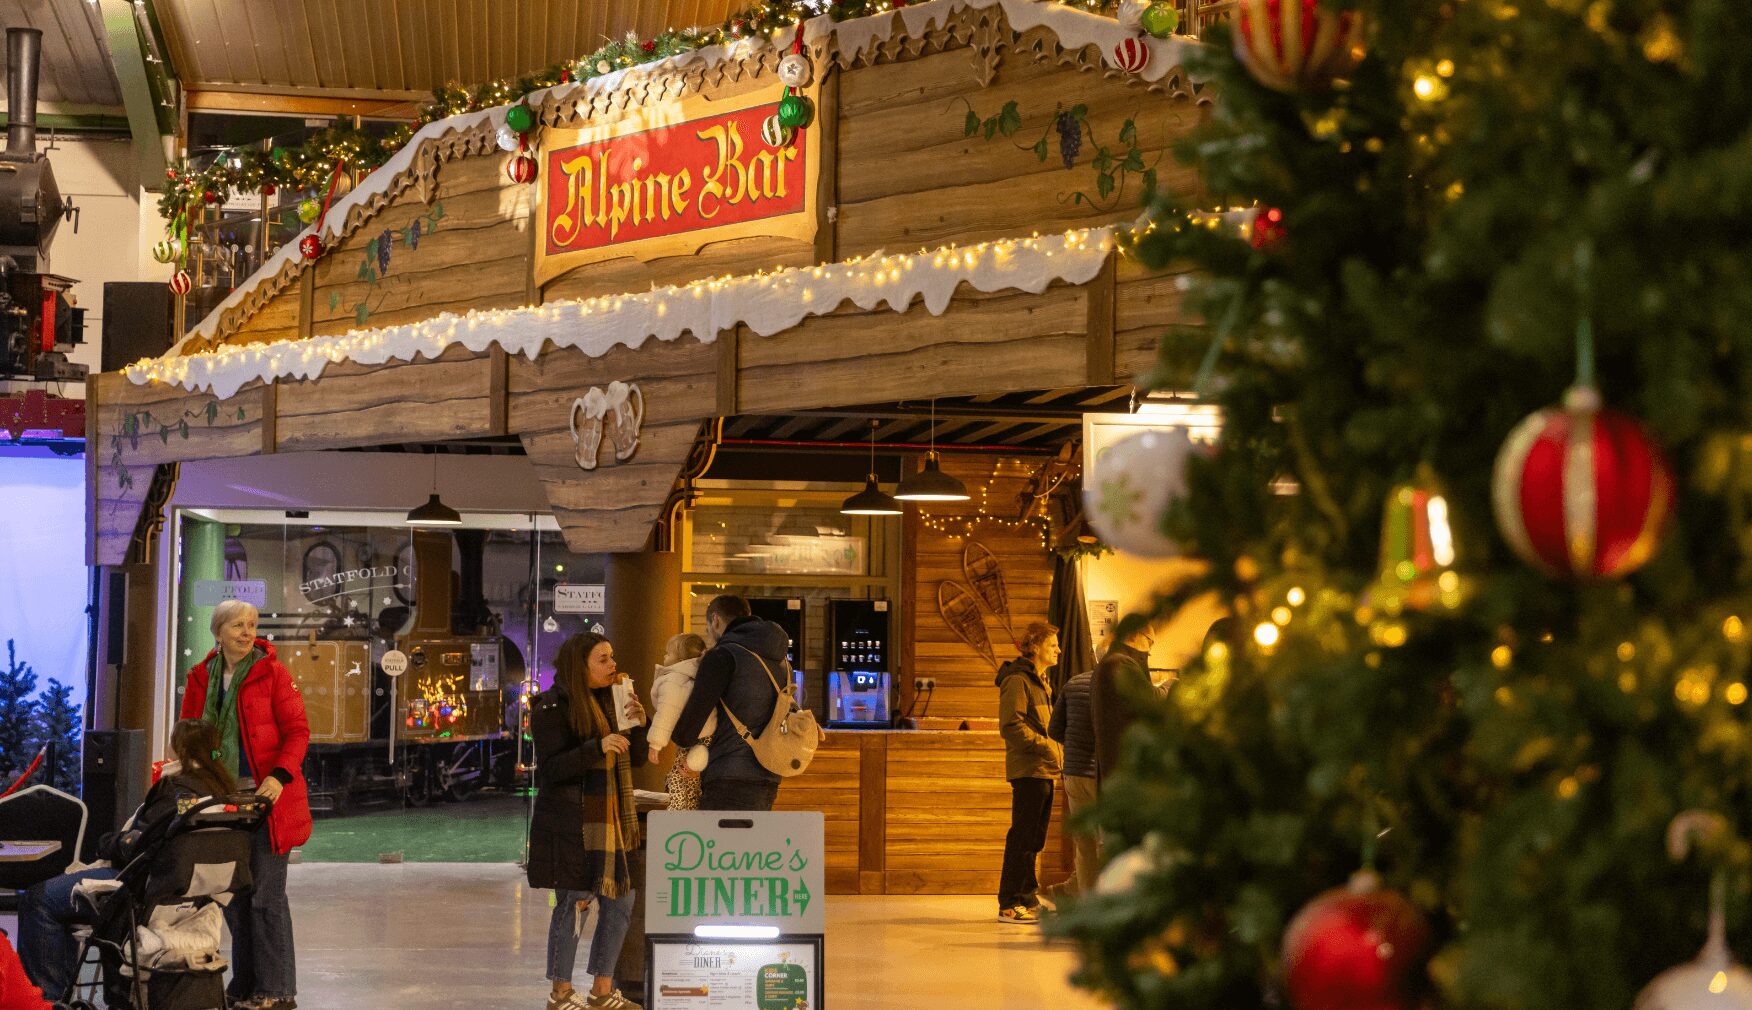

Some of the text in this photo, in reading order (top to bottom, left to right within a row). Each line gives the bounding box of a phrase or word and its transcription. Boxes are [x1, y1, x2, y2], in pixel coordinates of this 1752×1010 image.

[552, 120, 798, 246] Alpine Bar
[298, 565, 398, 594] STATFOLD
[384, 664, 403, 672] PULL
[664, 830, 808, 872] Diane's
[666, 877, 792, 917] DINER
[693, 956, 721, 969] DINER
